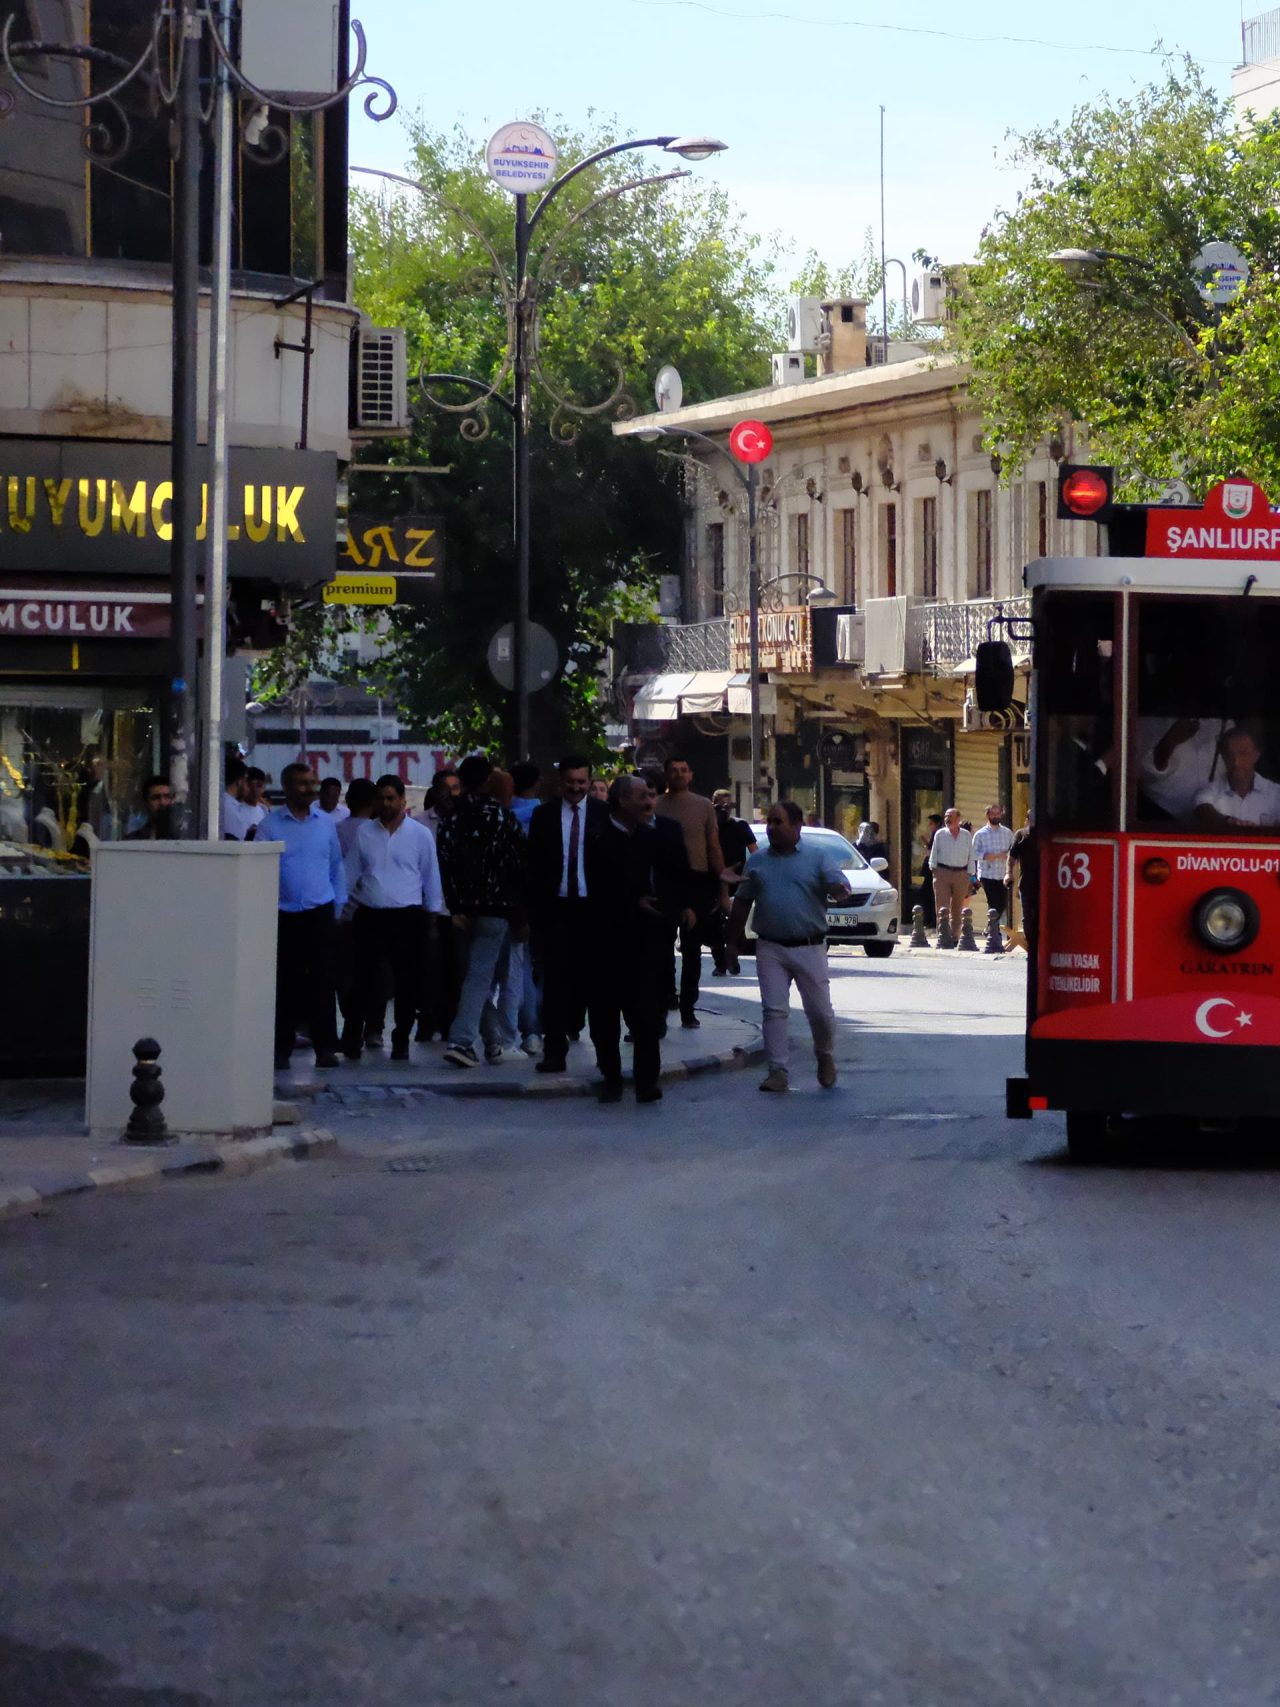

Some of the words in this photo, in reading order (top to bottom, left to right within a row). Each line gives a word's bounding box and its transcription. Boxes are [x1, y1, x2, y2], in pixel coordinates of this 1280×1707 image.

[326, 583, 393, 596] premium
[1058, 852, 1091, 889] 63
[1177, 853, 1280, 872] DİVANYOLU-01
[1073, 954, 1100, 969] YASAK
